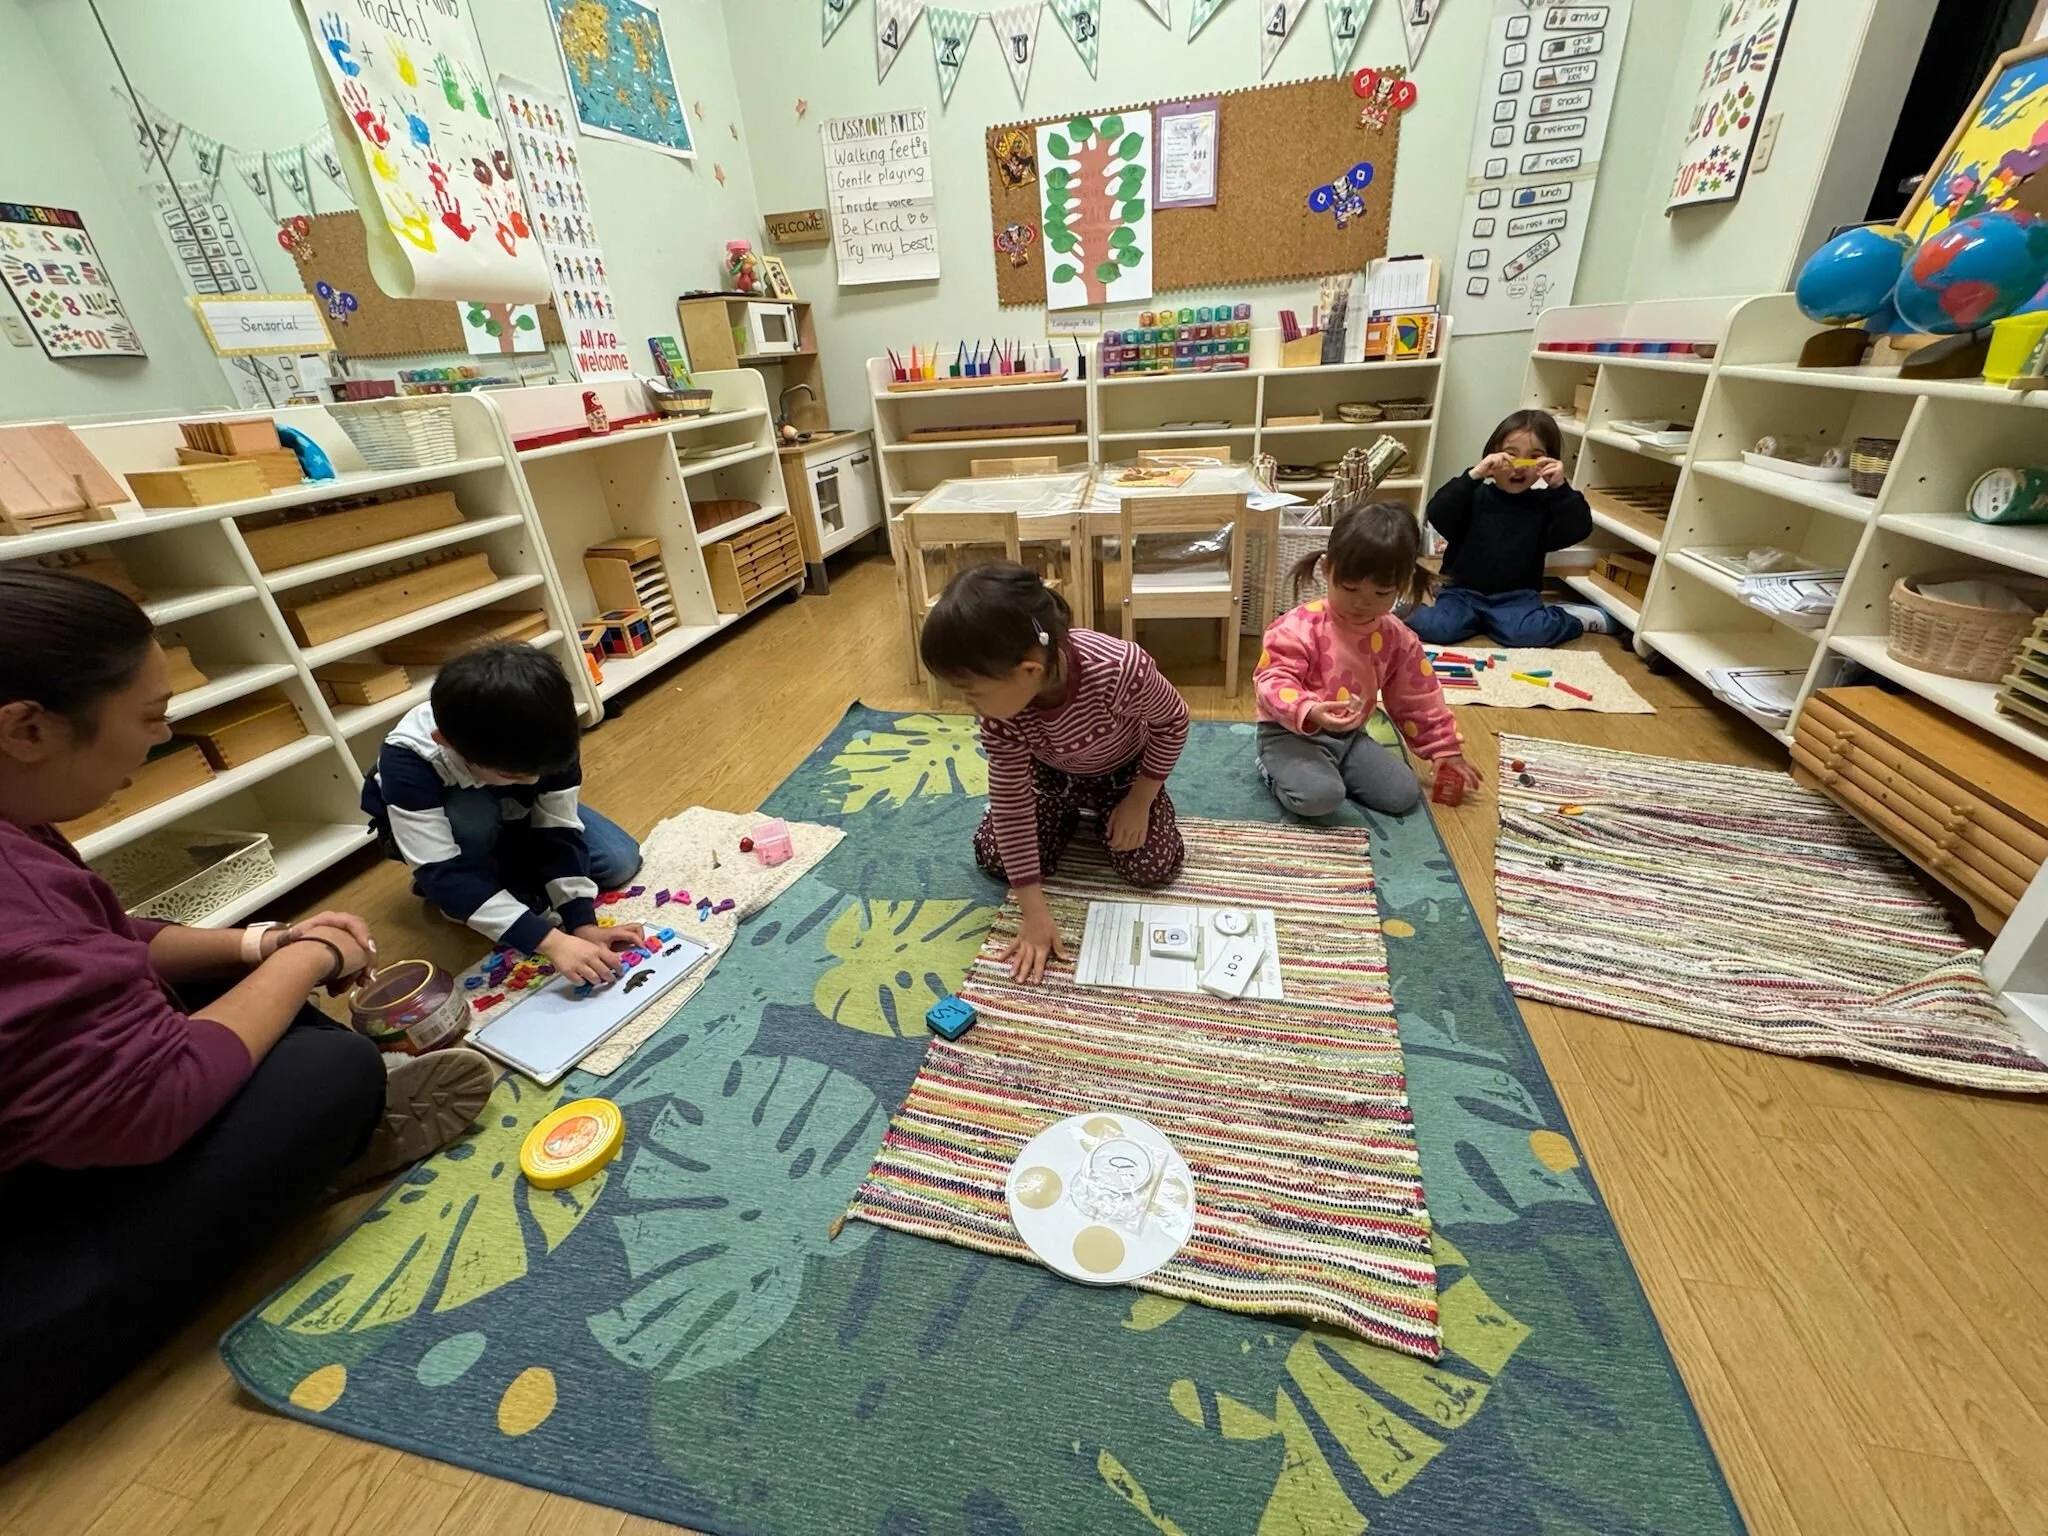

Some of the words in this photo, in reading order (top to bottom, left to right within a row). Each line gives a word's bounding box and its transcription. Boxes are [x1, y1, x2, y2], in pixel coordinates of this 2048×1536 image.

[1570, 11, 1601, 22] arrival
[1737, 34, 1757, 73] 6
[1557, 95, 1583, 107] snack
[830, 115, 888, 142] CLASSROOM
[1543, 123, 1582, 135] restroom
[1702, 101, 1719, 137] 8
[834, 145, 885, 166] Walking
[890, 137, 919, 160] feet
[1545, 154, 1576, 167] recess
[837, 170, 872, 189] Gentle
[878, 167, 925, 185] playing
[1674, 162, 1697, 197] 10
[1540, 187, 1562, 199] lunch
[768, 218, 822, 236] WELCOME
[842, 218, 860, 235] Be
[863, 215, 903, 236] Kind
[843, 238, 865, 264] Try
[871, 242, 894, 261] my
[899, 234, 935, 254] best!
[240, 315, 299, 333] Sensorial
[580, 328, 595, 350] All
[597, 330, 617, 349] Are
[577, 351, 629, 373] Welcome
[1223, 954, 1243, 978] cat
